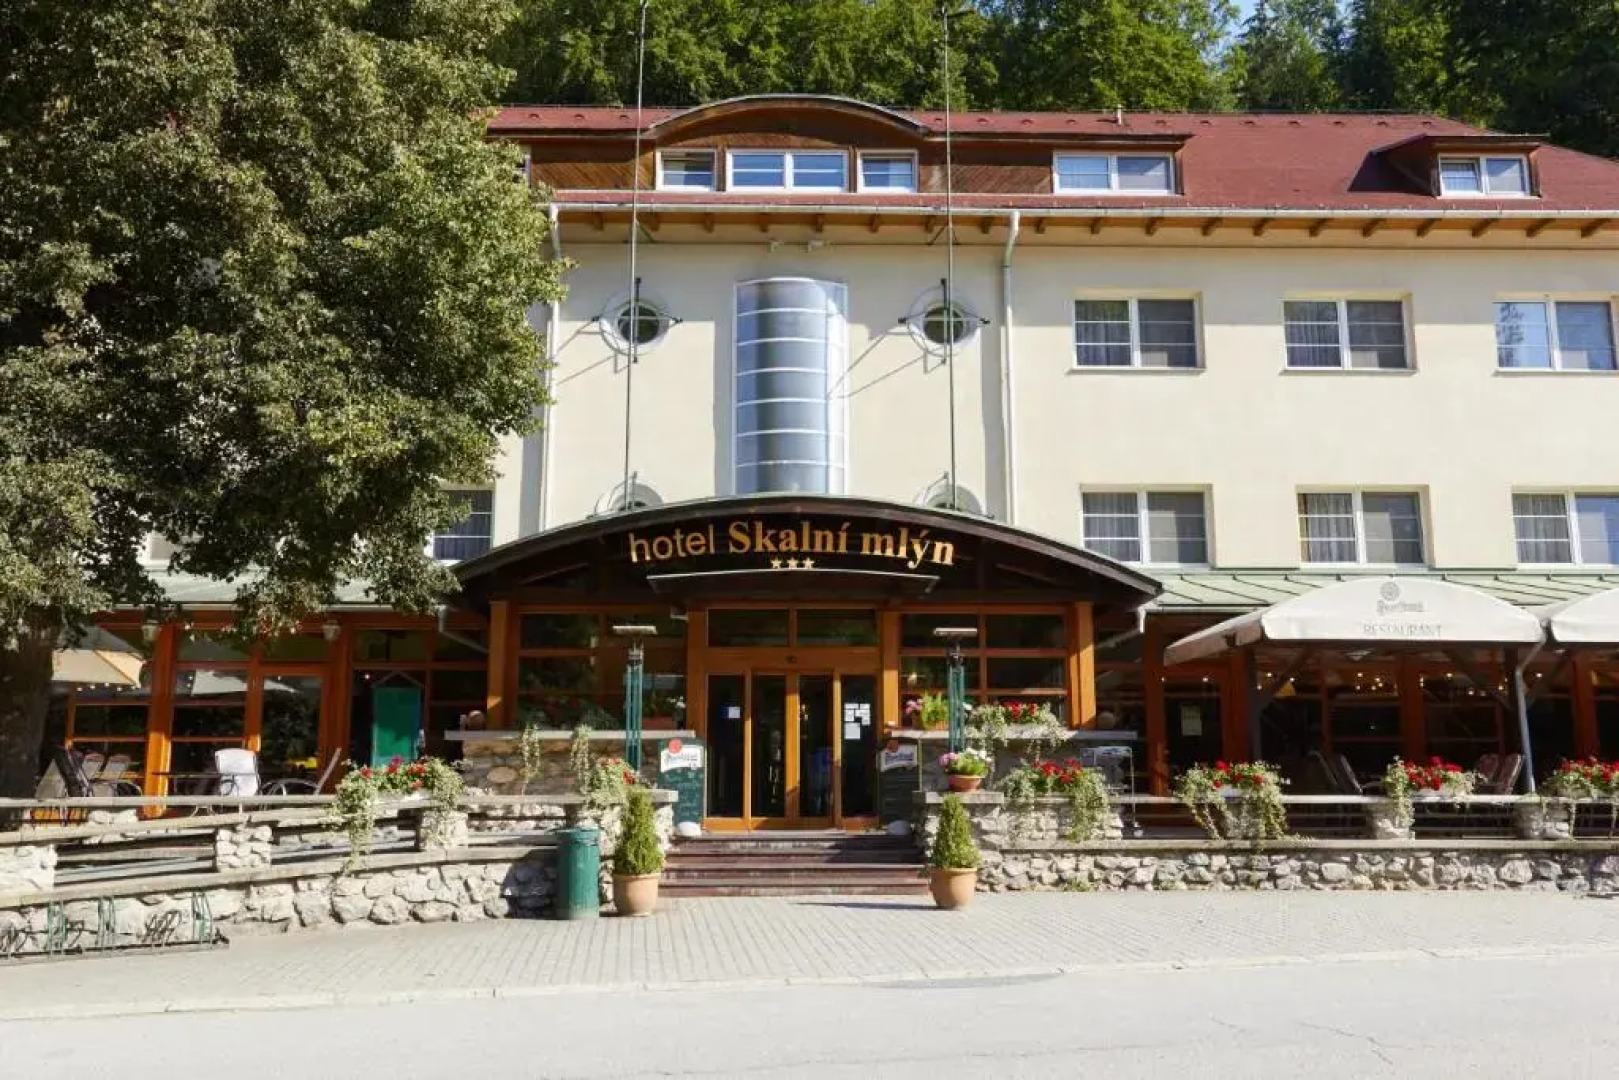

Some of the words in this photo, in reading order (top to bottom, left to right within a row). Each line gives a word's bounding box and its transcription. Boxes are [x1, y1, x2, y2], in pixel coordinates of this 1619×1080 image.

[628, 524, 715, 563] hotel
[728, 520, 850, 553] Skalní
[860, 527, 955, 569] mlýn
[1363, 624, 1442, 637] RESTAURANT
